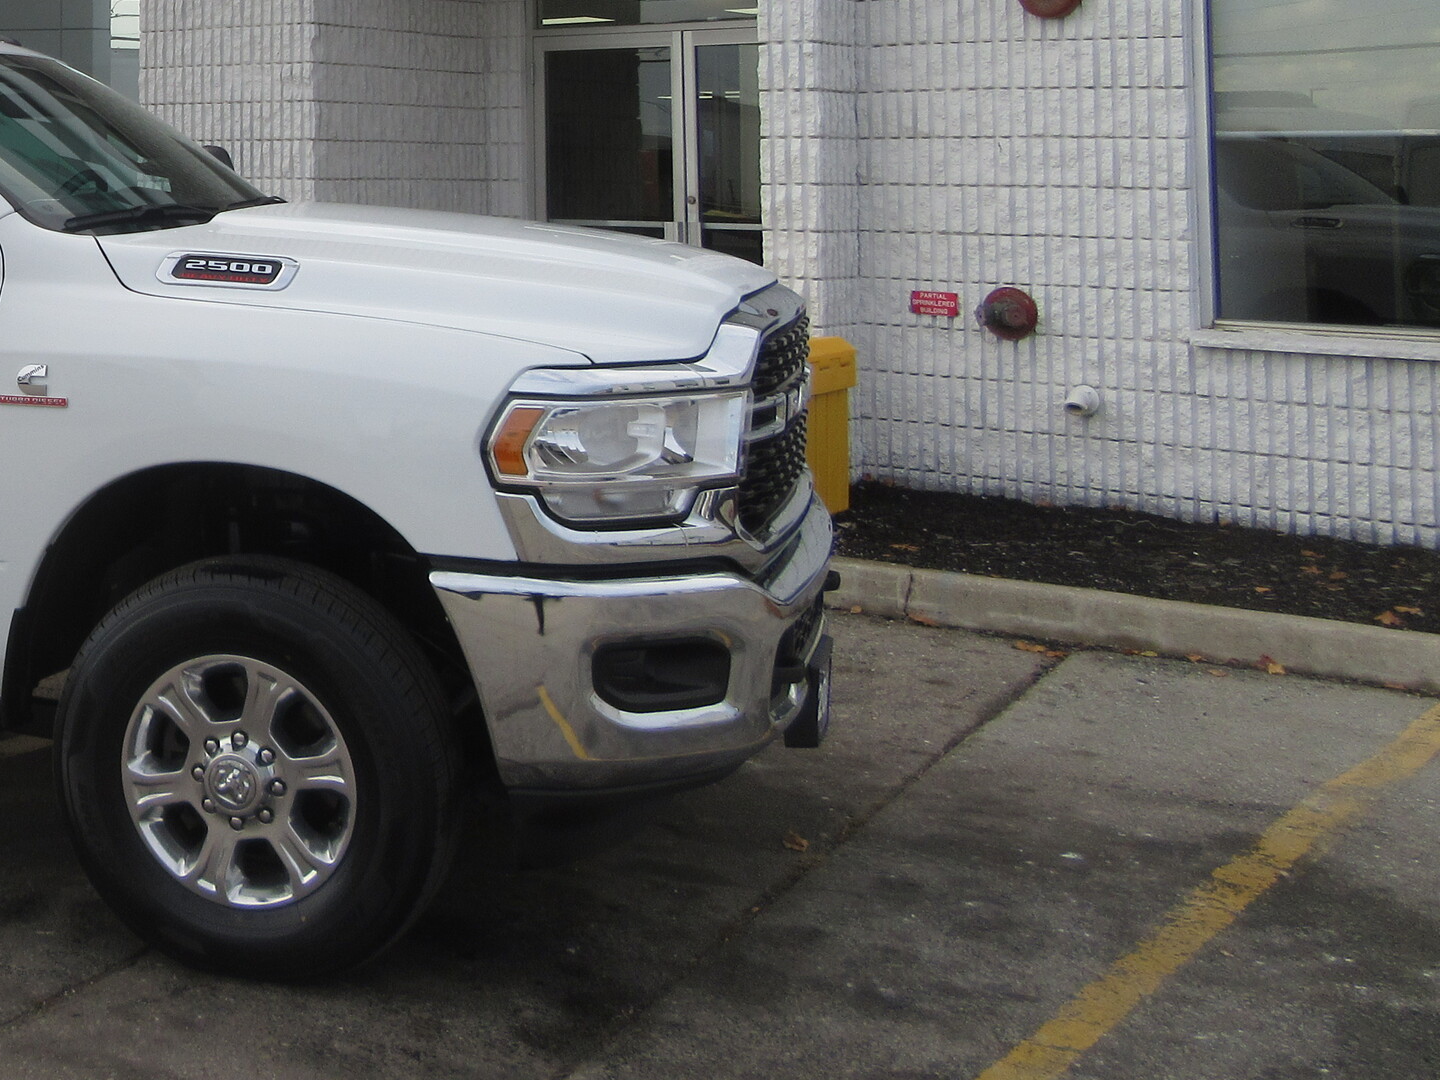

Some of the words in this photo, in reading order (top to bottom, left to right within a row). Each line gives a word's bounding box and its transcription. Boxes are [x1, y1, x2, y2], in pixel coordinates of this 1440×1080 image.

[185, 259, 273, 275] 2500
[920, 292, 947, 300] PARTIAL
[912, 299, 956, 308] SPRINKLERED
[920, 307, 948, 315] BUILDING
[17, 363, 45, 381] Cummins
